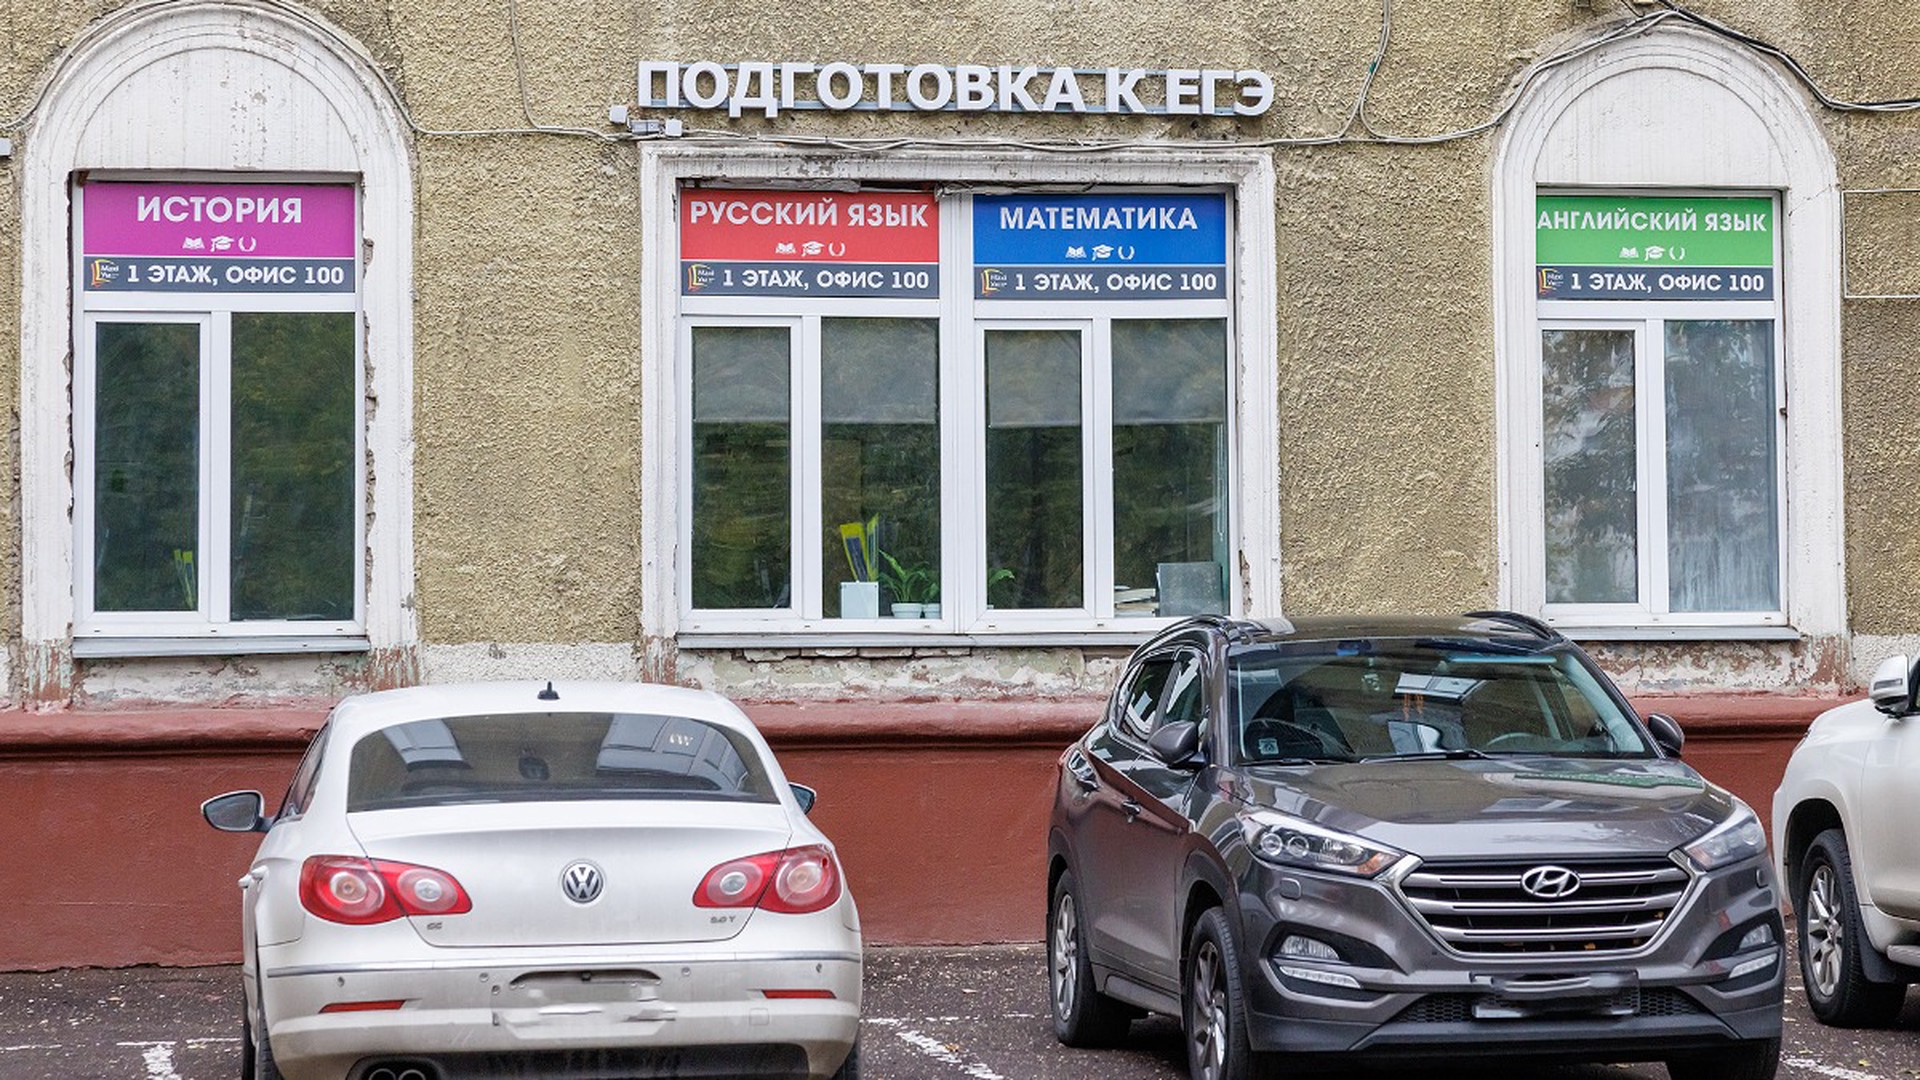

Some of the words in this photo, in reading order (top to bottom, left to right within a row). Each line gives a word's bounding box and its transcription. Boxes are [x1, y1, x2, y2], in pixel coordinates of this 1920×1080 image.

[638, 61, 1087, 118] ПОДГОТОВКА
[1105, 66, 1149, 114] К
[1165, 69, 1275, 116] ЕГЭ
[137, 196, 302, 223] ИСТОРИЯ
[690, 197, 838, 226] РУССКИЙ
[847, 203, 928, 227] ЯЗЫК
[1000, 207, 1198, 230] МАТЕМАТИКА
[1537, 207, 1697, 232] АНГЛИЙСКИЙ
[1704, 212, 1767, 232] ЯЗЫК
[127, 265, 140, 283] 1
[147, 265, 218, 286] ЭТАЖ,
[225, 265, 297, 284] ОФИС
[304, 266, 345, 284] 100
[723, 269, 734, 286] 1
[742, 269, 809, 291] ЭТАЖ,
[816, 270, 884, 289] ОФИС
[891, 271, 930, 289] 100
[1015, 273, 1026, 291] 1
[1034, 273, 1100, 294] ЭТАЖ,
[1106, 273, 1172, 291] ОФИС
[1180, 273, 1217, 291] 100
[1571, 273, 1582, 290] 1
[1589, 273, 1652, 294] ЭТАЖ,
[1658, 273, 1722, 292] ОФИС
[1729, 274, 1765, 292] 100
